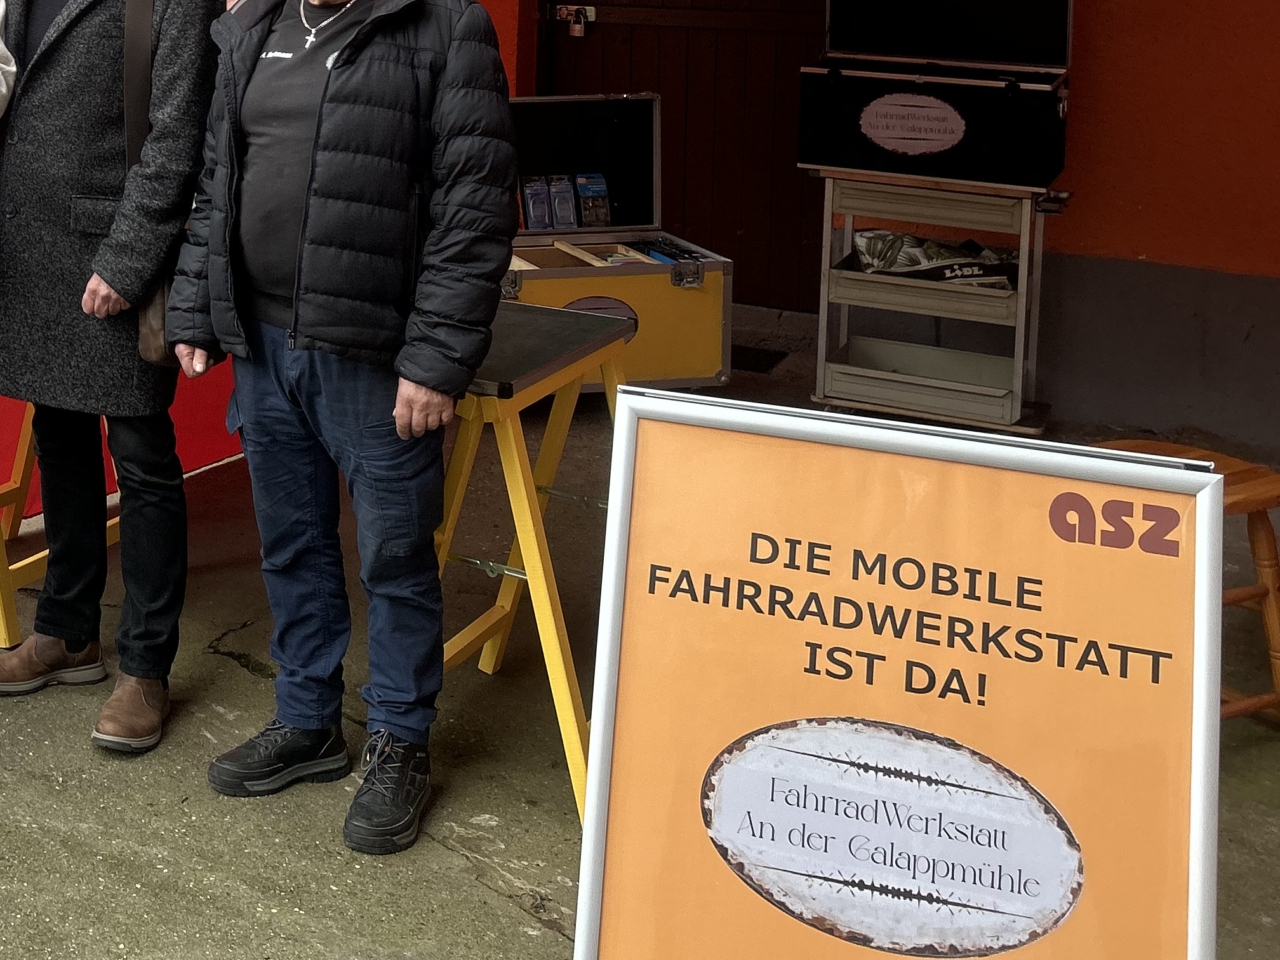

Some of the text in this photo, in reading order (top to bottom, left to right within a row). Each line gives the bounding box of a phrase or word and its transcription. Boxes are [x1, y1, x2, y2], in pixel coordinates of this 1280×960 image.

[1048, 491, 1181, 558] asz
[749, 531, 1044, 612] DIE MOBILE
[647, 563, 1173, 685] FAHRRADWERKSTATT
[803, 641, 988, 707] IST DA!
[735, 809, 1041, 899] An der Galappmühle
[769, 776, 1009, 853] FahrradWerkstatt
